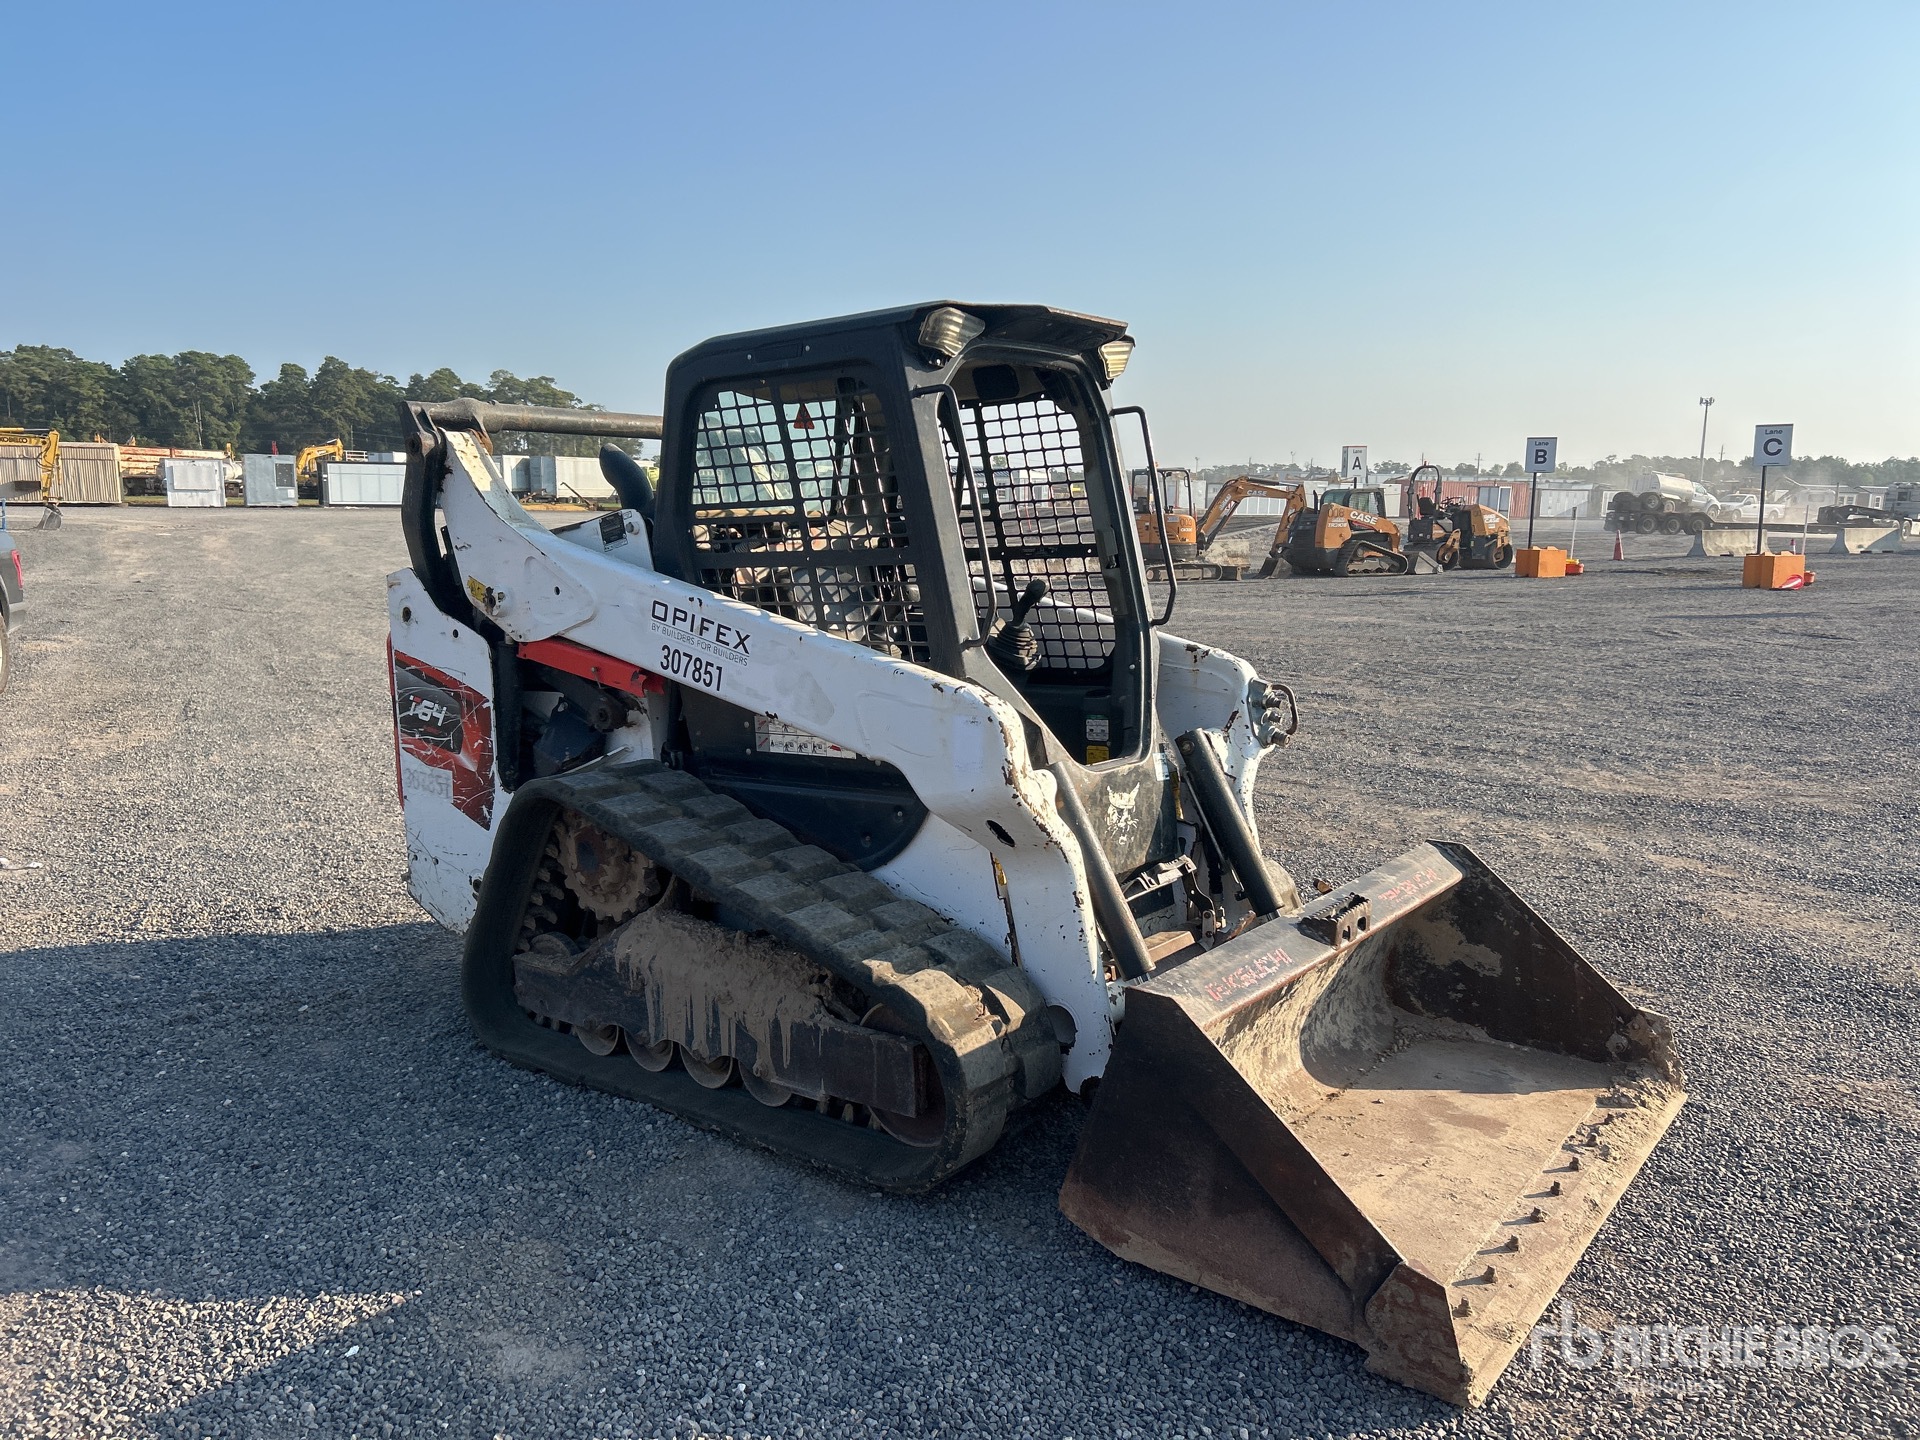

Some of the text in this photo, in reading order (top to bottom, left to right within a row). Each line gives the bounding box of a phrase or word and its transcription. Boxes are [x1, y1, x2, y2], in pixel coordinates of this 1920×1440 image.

[1763, 437, 1783, 456] C
[1352, 456, 1362, 470] A
[1534, 448, 1548, 465] B
[1246, 489, 1268, 497] CASE
[1350, 510, 1378, 525] CASE
[651, 600, 751, 655] OPIFEX
[651, 623, 748, 667] BY BUILDERS FOR BUILDERS
[660, 644, 723, 692] 307851
